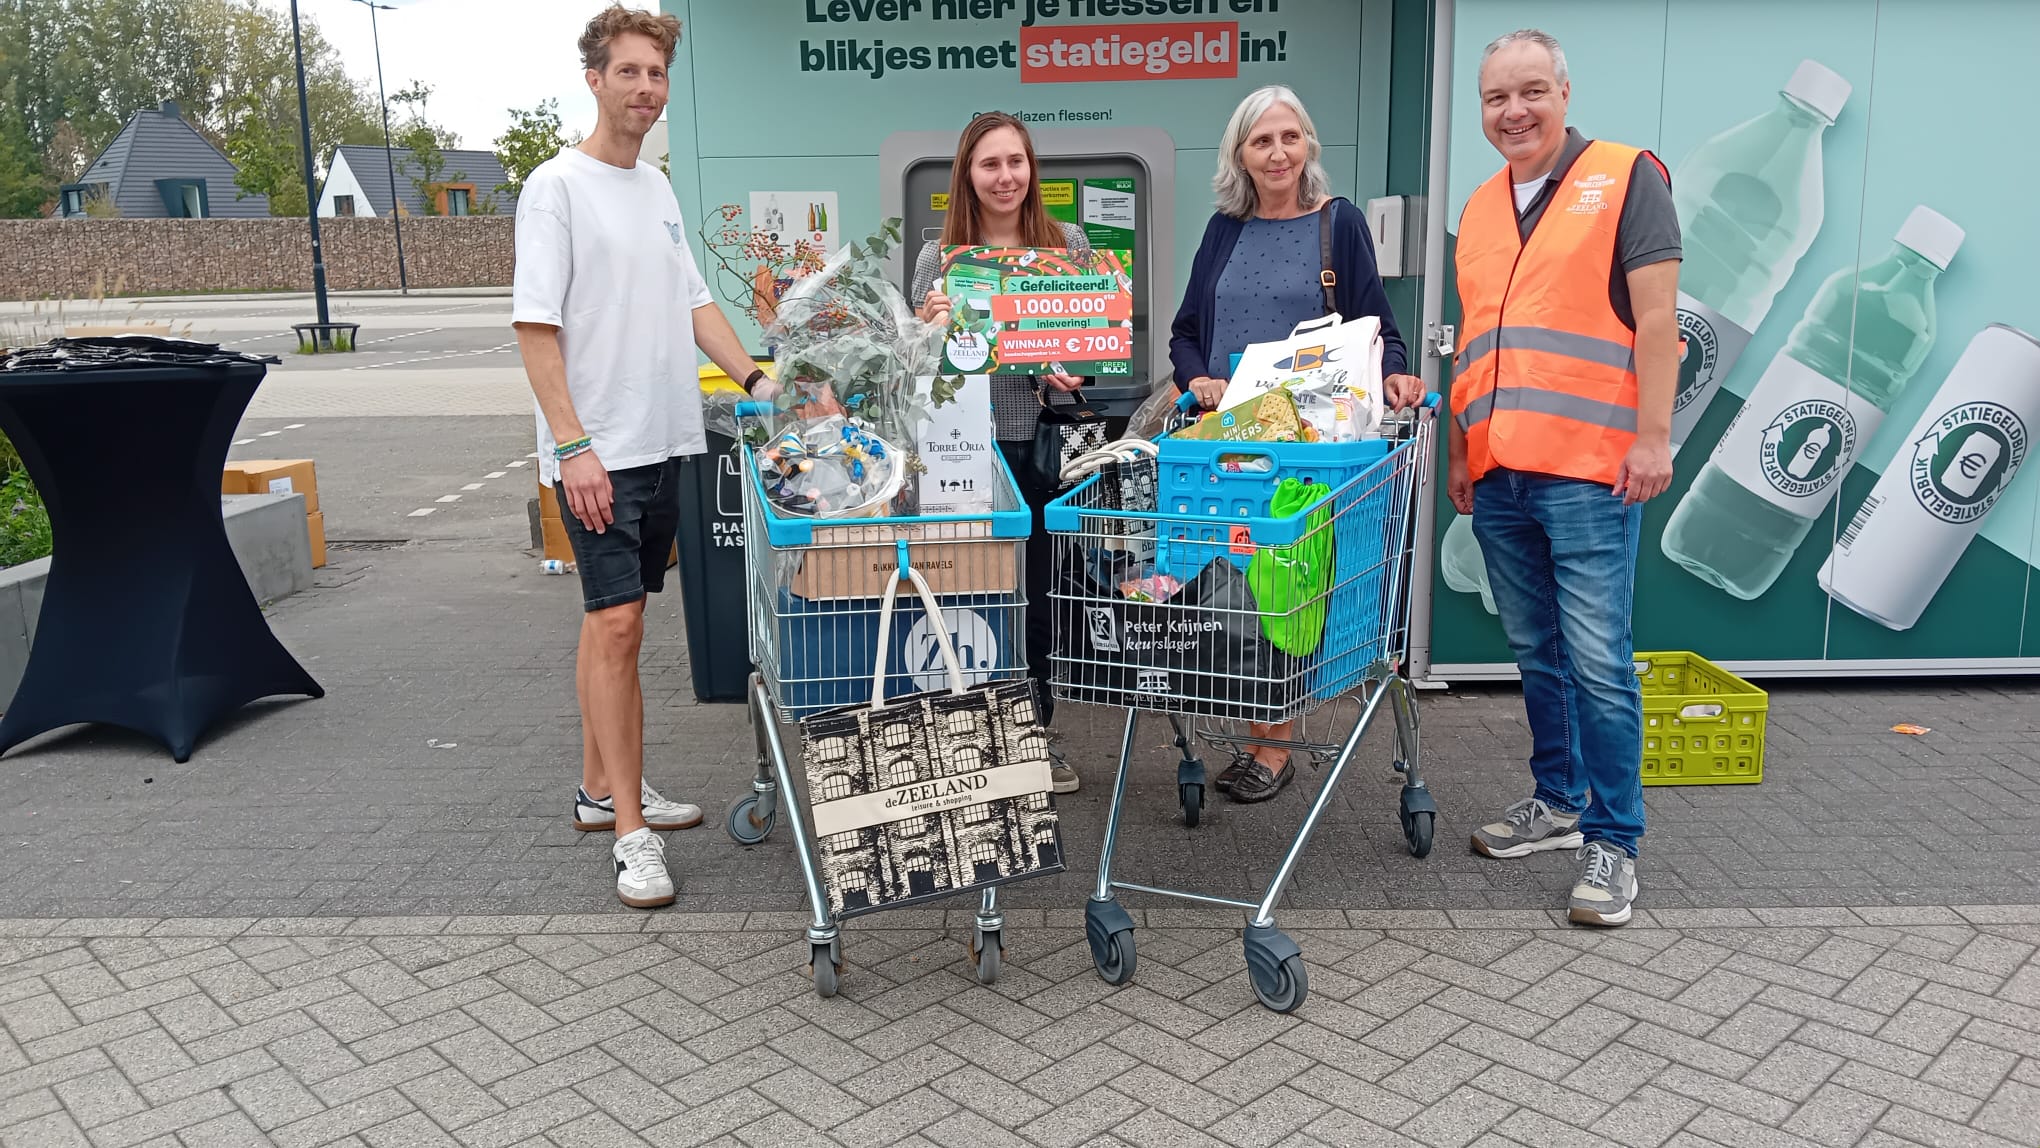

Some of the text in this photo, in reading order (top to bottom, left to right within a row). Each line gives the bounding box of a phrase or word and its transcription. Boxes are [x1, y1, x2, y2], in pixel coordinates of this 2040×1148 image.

[806, 0, 922, 22] Lever
[1021, 0, 1060, 26] je
[800, 30, 1287, 79] blikjes met statiegeld in!
[1059, 109, 1112, 121] flessen!
[1020, 279, 1109, 291] Gefeliciteerd!
[1036, 318, 1091, 328] inlevering!
[1003, 338, 1060, 349] WINNAAR
[1065, 338, 1081, 352] €
[1223, 424, 1240, 440] MINI
[1784, 404, 1853, 453] STATIEGELDFLES
[1942, 407, 2024, 469] STATIEGELDBLIK
[1764, 442, 1832, 493] STATIEGELDFLES
[1915, 457, 1994, 519] STATIEGELDBLIK
[873, 562, 900, 572] BAKK
[1125, 619, 1223, 636] Peter Krijnen
[1126, 636, 1199, 654] keurslager
[912, 803, 933, 811] leisure
[943, 794, 972, 806] shopping
